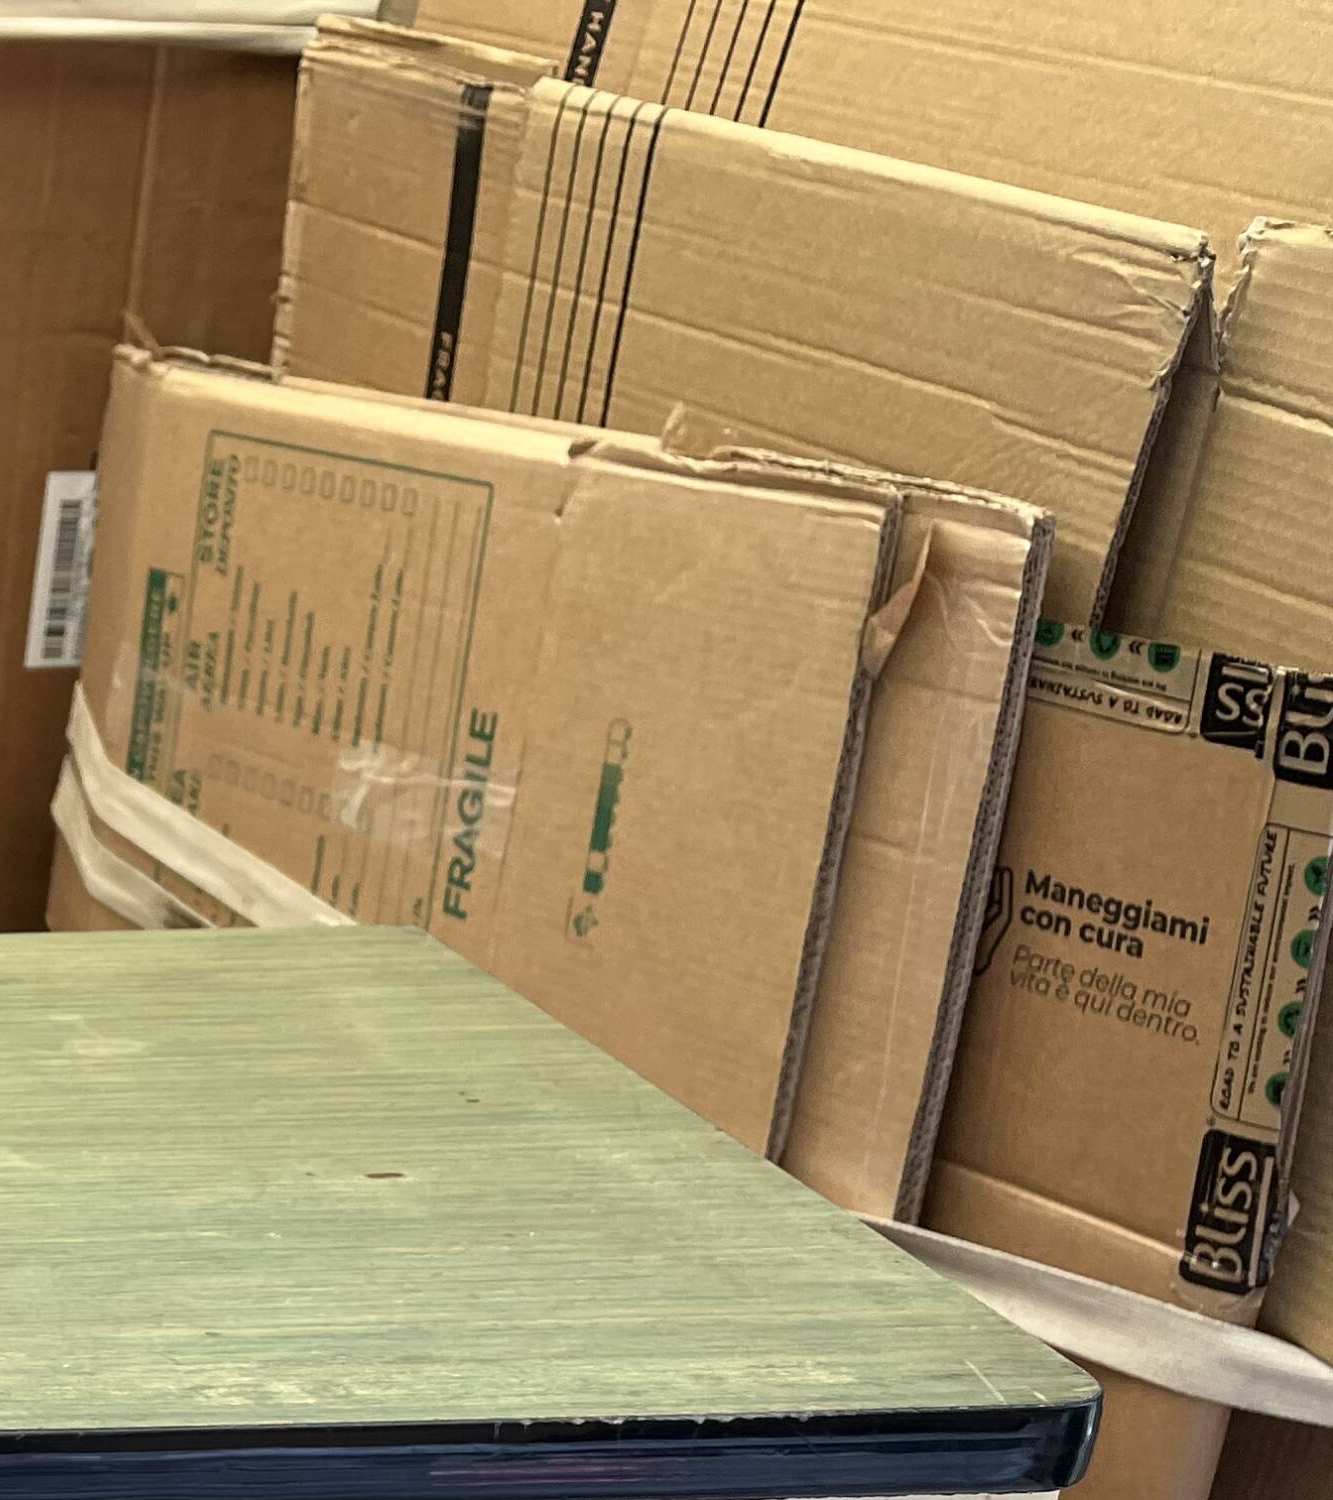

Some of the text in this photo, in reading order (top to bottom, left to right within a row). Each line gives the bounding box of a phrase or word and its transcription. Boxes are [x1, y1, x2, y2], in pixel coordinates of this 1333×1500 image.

[197, 459, 225, 564] STORE
[442, 707, 498, 920] FRAGILE
[1020, 905, 1144, 959] con cura
[1025, 868, 1211, 945] Maneggiami
[1010, 969, 1200, 1046] vita è qui dentro.
[1012, 944, 1192, 1018] Parte della mia
[1219, 829, 1278, 1111] ROAD TO A SUSTAINABLE FUTURE
